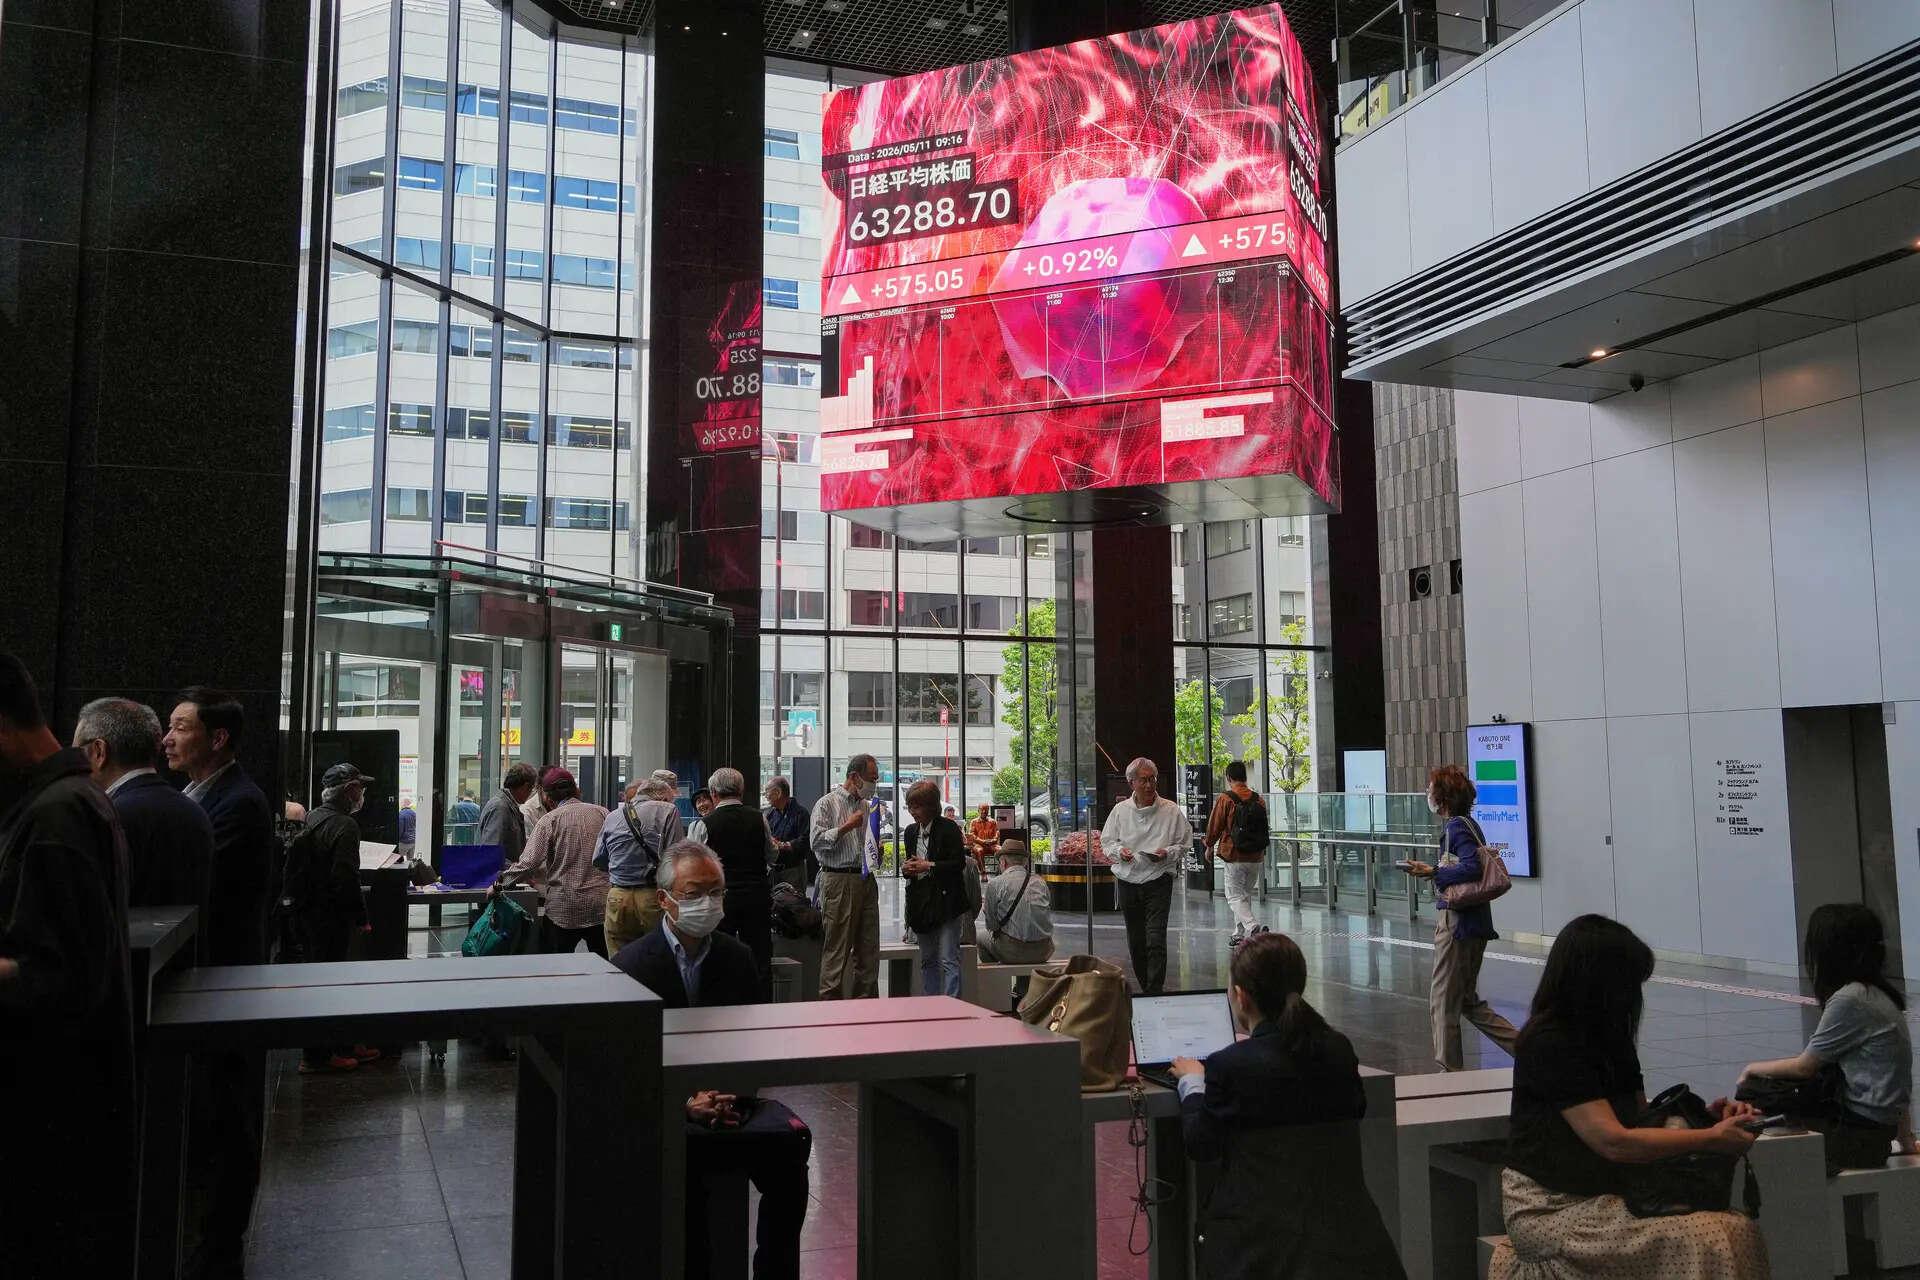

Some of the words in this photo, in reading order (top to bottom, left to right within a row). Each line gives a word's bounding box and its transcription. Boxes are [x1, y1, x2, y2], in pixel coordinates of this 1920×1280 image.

[848, 152, 870, 164] Data
[876, 140, 931, 160] 2026/05/11
[935, 134, 963, 148] 09:16
[850, 158, 972, 200] 日経平均株価
[1290, 160, 1328, 242] 63288.70
[850, 187, 1012, 241] 63288.70
[871, 268, 964, 298] +575.05
[1023, 246, 1118, 277] +0.92%
[1477, 810, 1520, 822] FamilyMart
